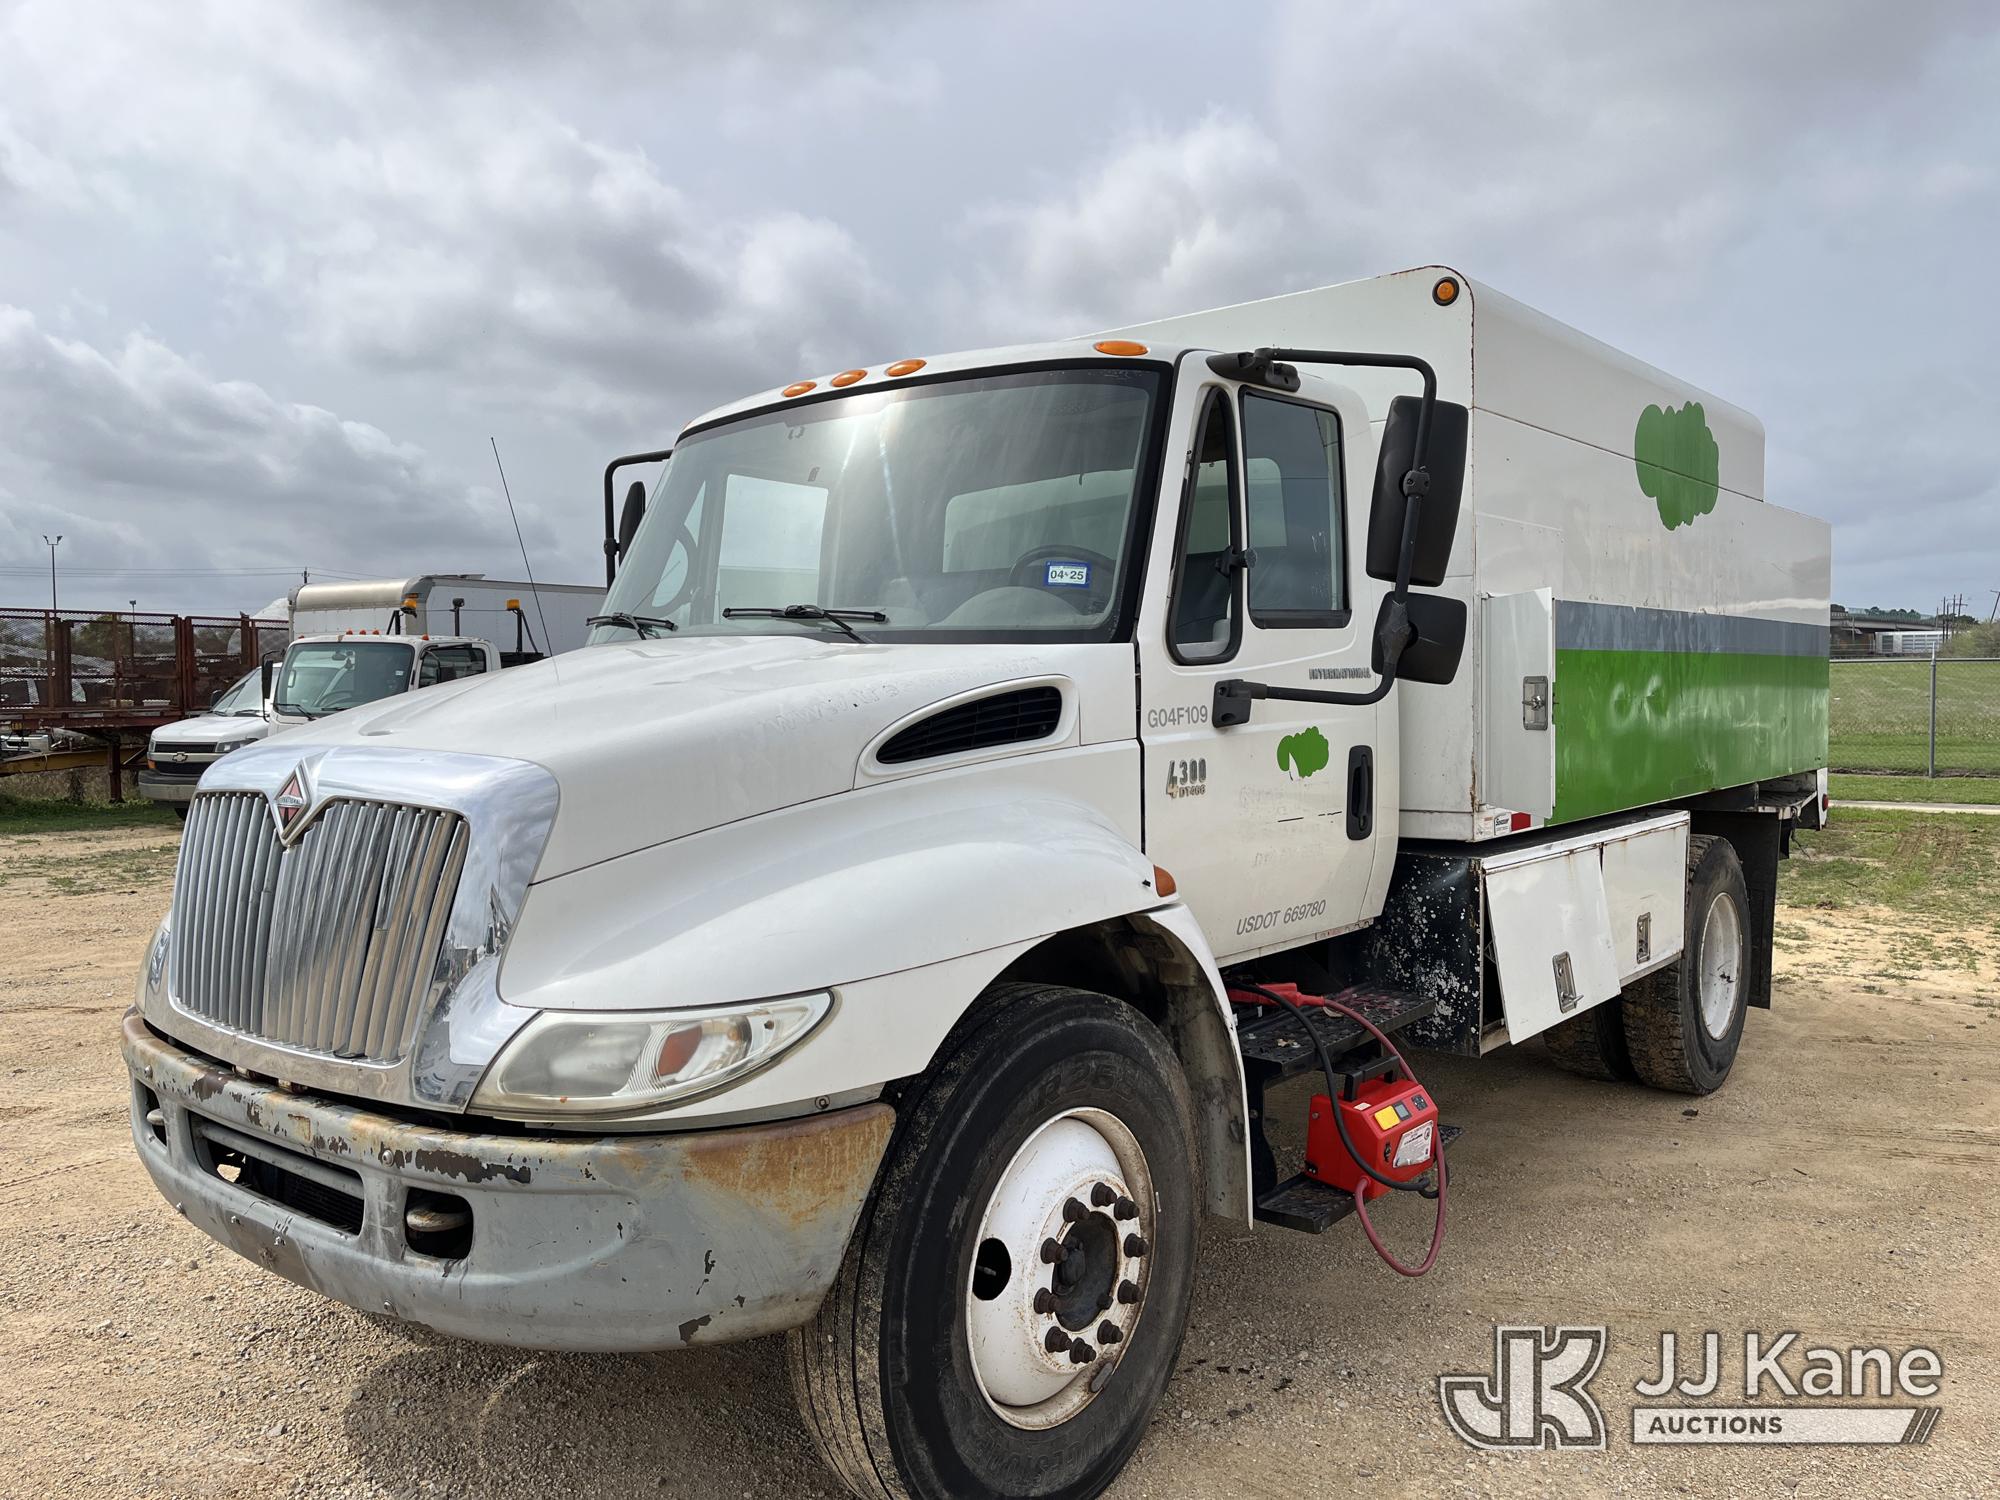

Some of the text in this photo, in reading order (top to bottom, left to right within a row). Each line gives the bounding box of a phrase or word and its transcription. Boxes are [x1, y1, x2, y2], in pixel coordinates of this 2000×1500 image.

[1308, 667, 1371, 680] INTERNATIONAL
[1147, 705, 1208, 728] G04F109
[1166, 758, 1206, 798] 4300
[1236, 899, 1326, 935] USDOT 669780
